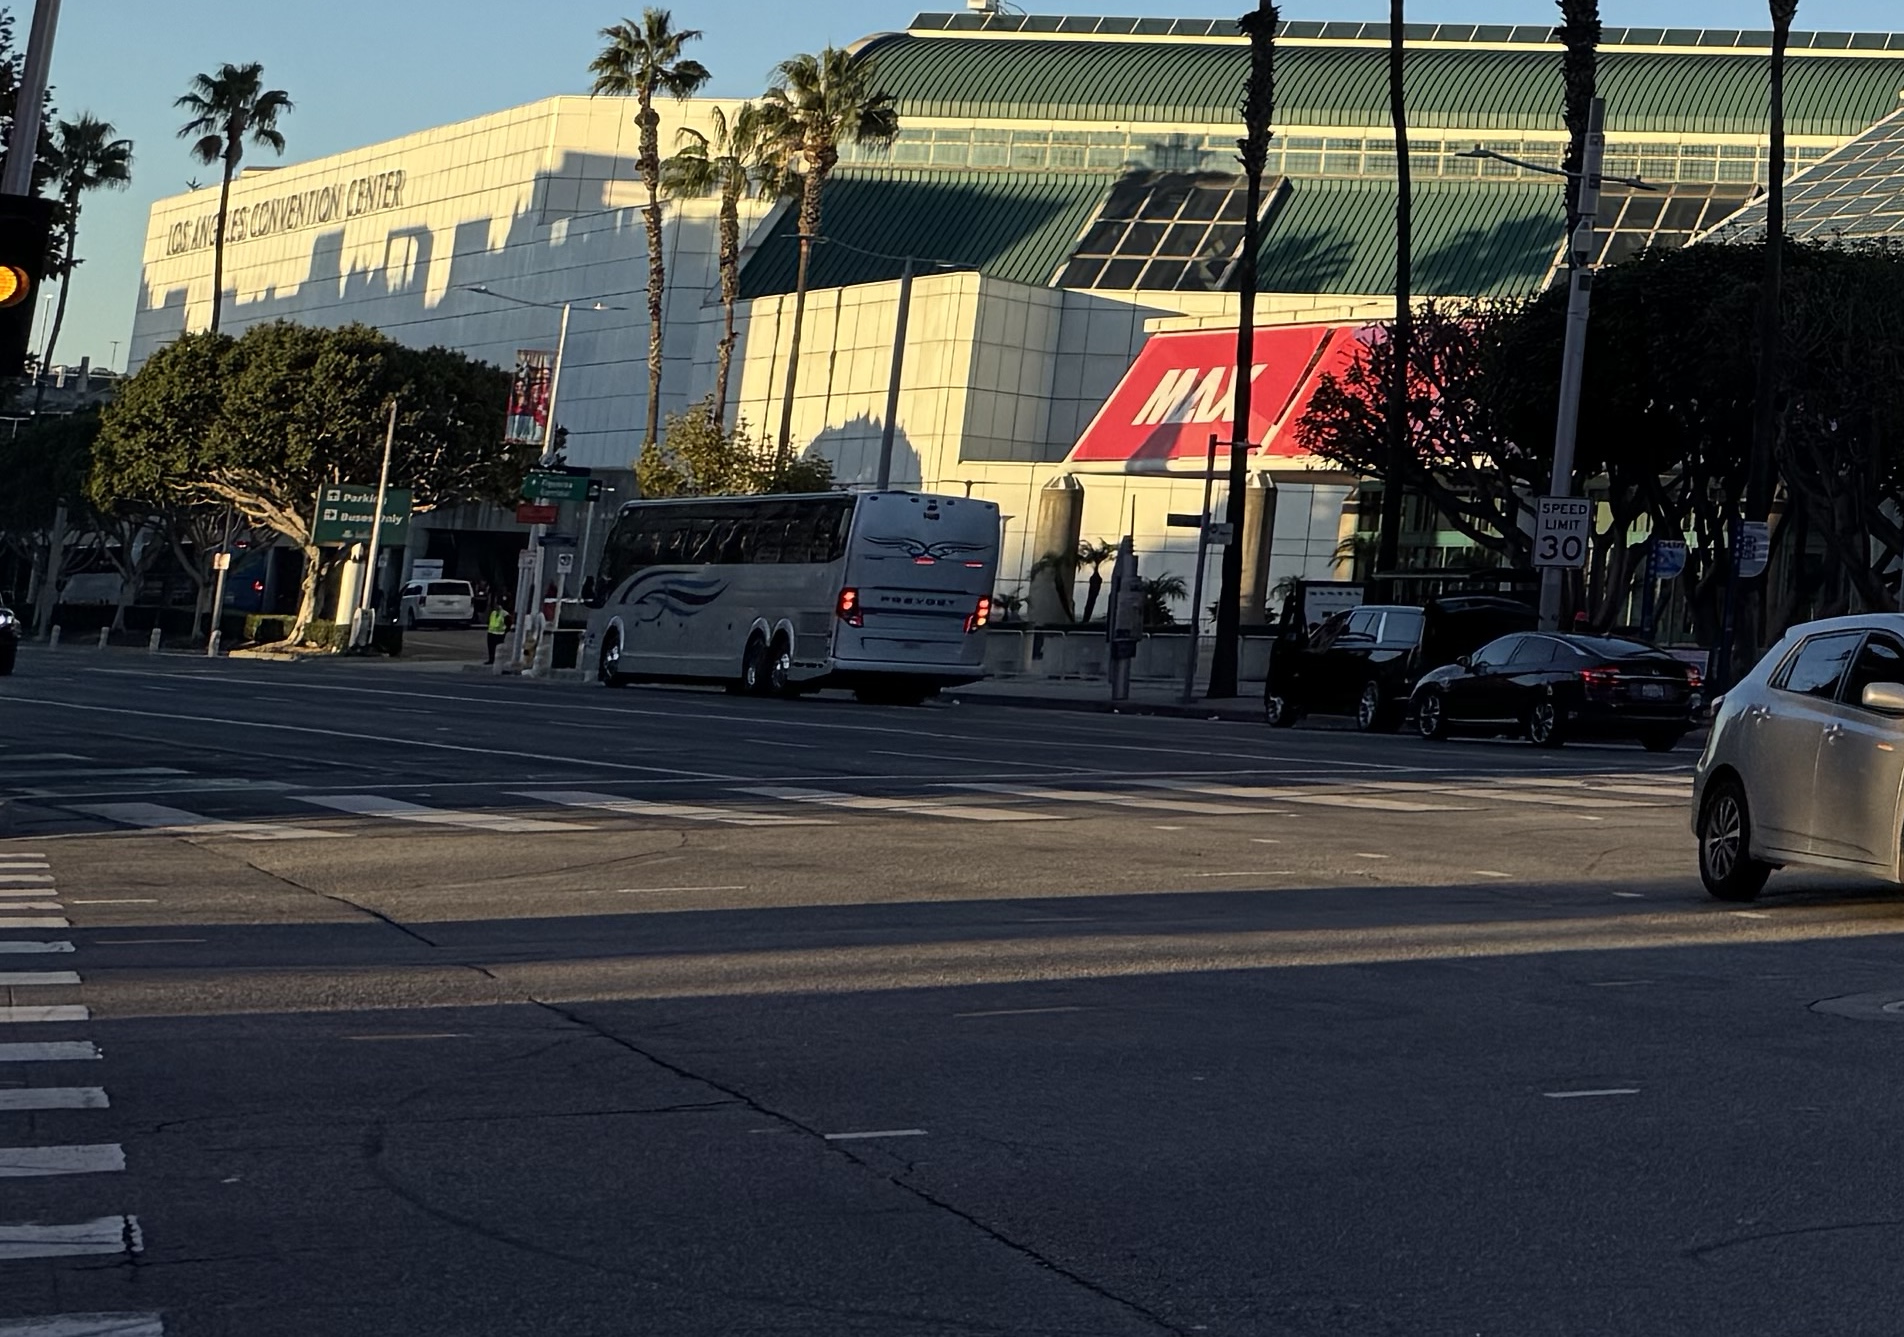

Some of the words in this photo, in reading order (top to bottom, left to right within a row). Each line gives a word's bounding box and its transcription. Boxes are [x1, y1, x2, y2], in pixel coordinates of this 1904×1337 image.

[166, 220, 193, 256] LOS
[191, 206, 251, 251] ANGLES
[250, 184, 345, 238] CONVENTION
[347, 169, 407, 218] CENTER
[1131, 363, 1269, 426] MAX
[1542, 503, 1588, 515] SPEED
[1545, 518, 1582, 530] LIMIT
[1539, 535, 1583, 561] 30
